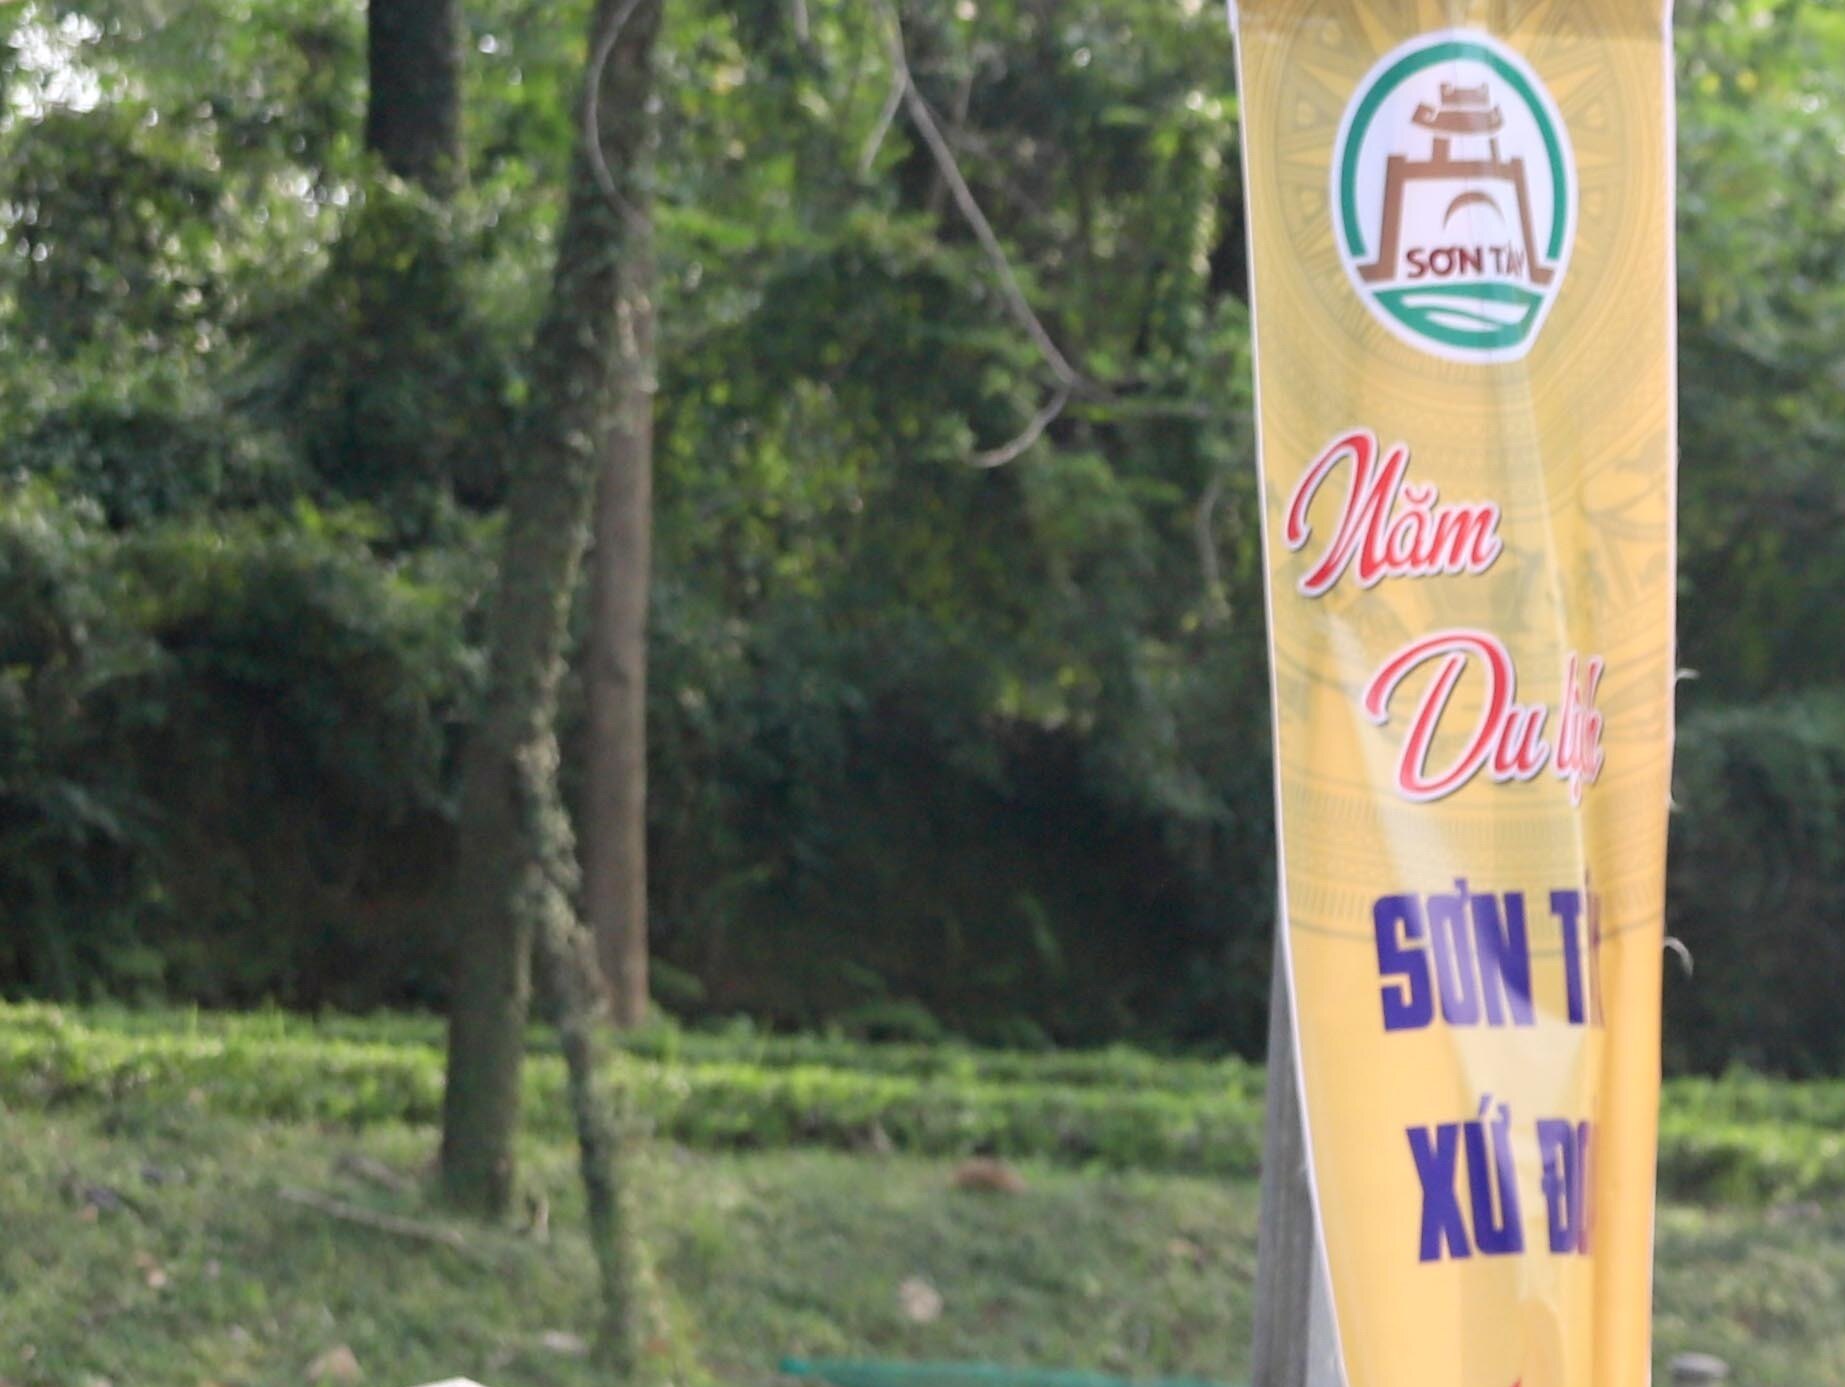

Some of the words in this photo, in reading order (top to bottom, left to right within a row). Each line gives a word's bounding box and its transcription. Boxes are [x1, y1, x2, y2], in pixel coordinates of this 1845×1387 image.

[1407, 246, 1484, 278] SƠN
[1283, 427, 1502, 597] Năm
[1363, 629, 1549, 801] Du
[1373, 878, 1535, 1032] SƠN
[1405, 1093, 1525, 1263] XỨ
